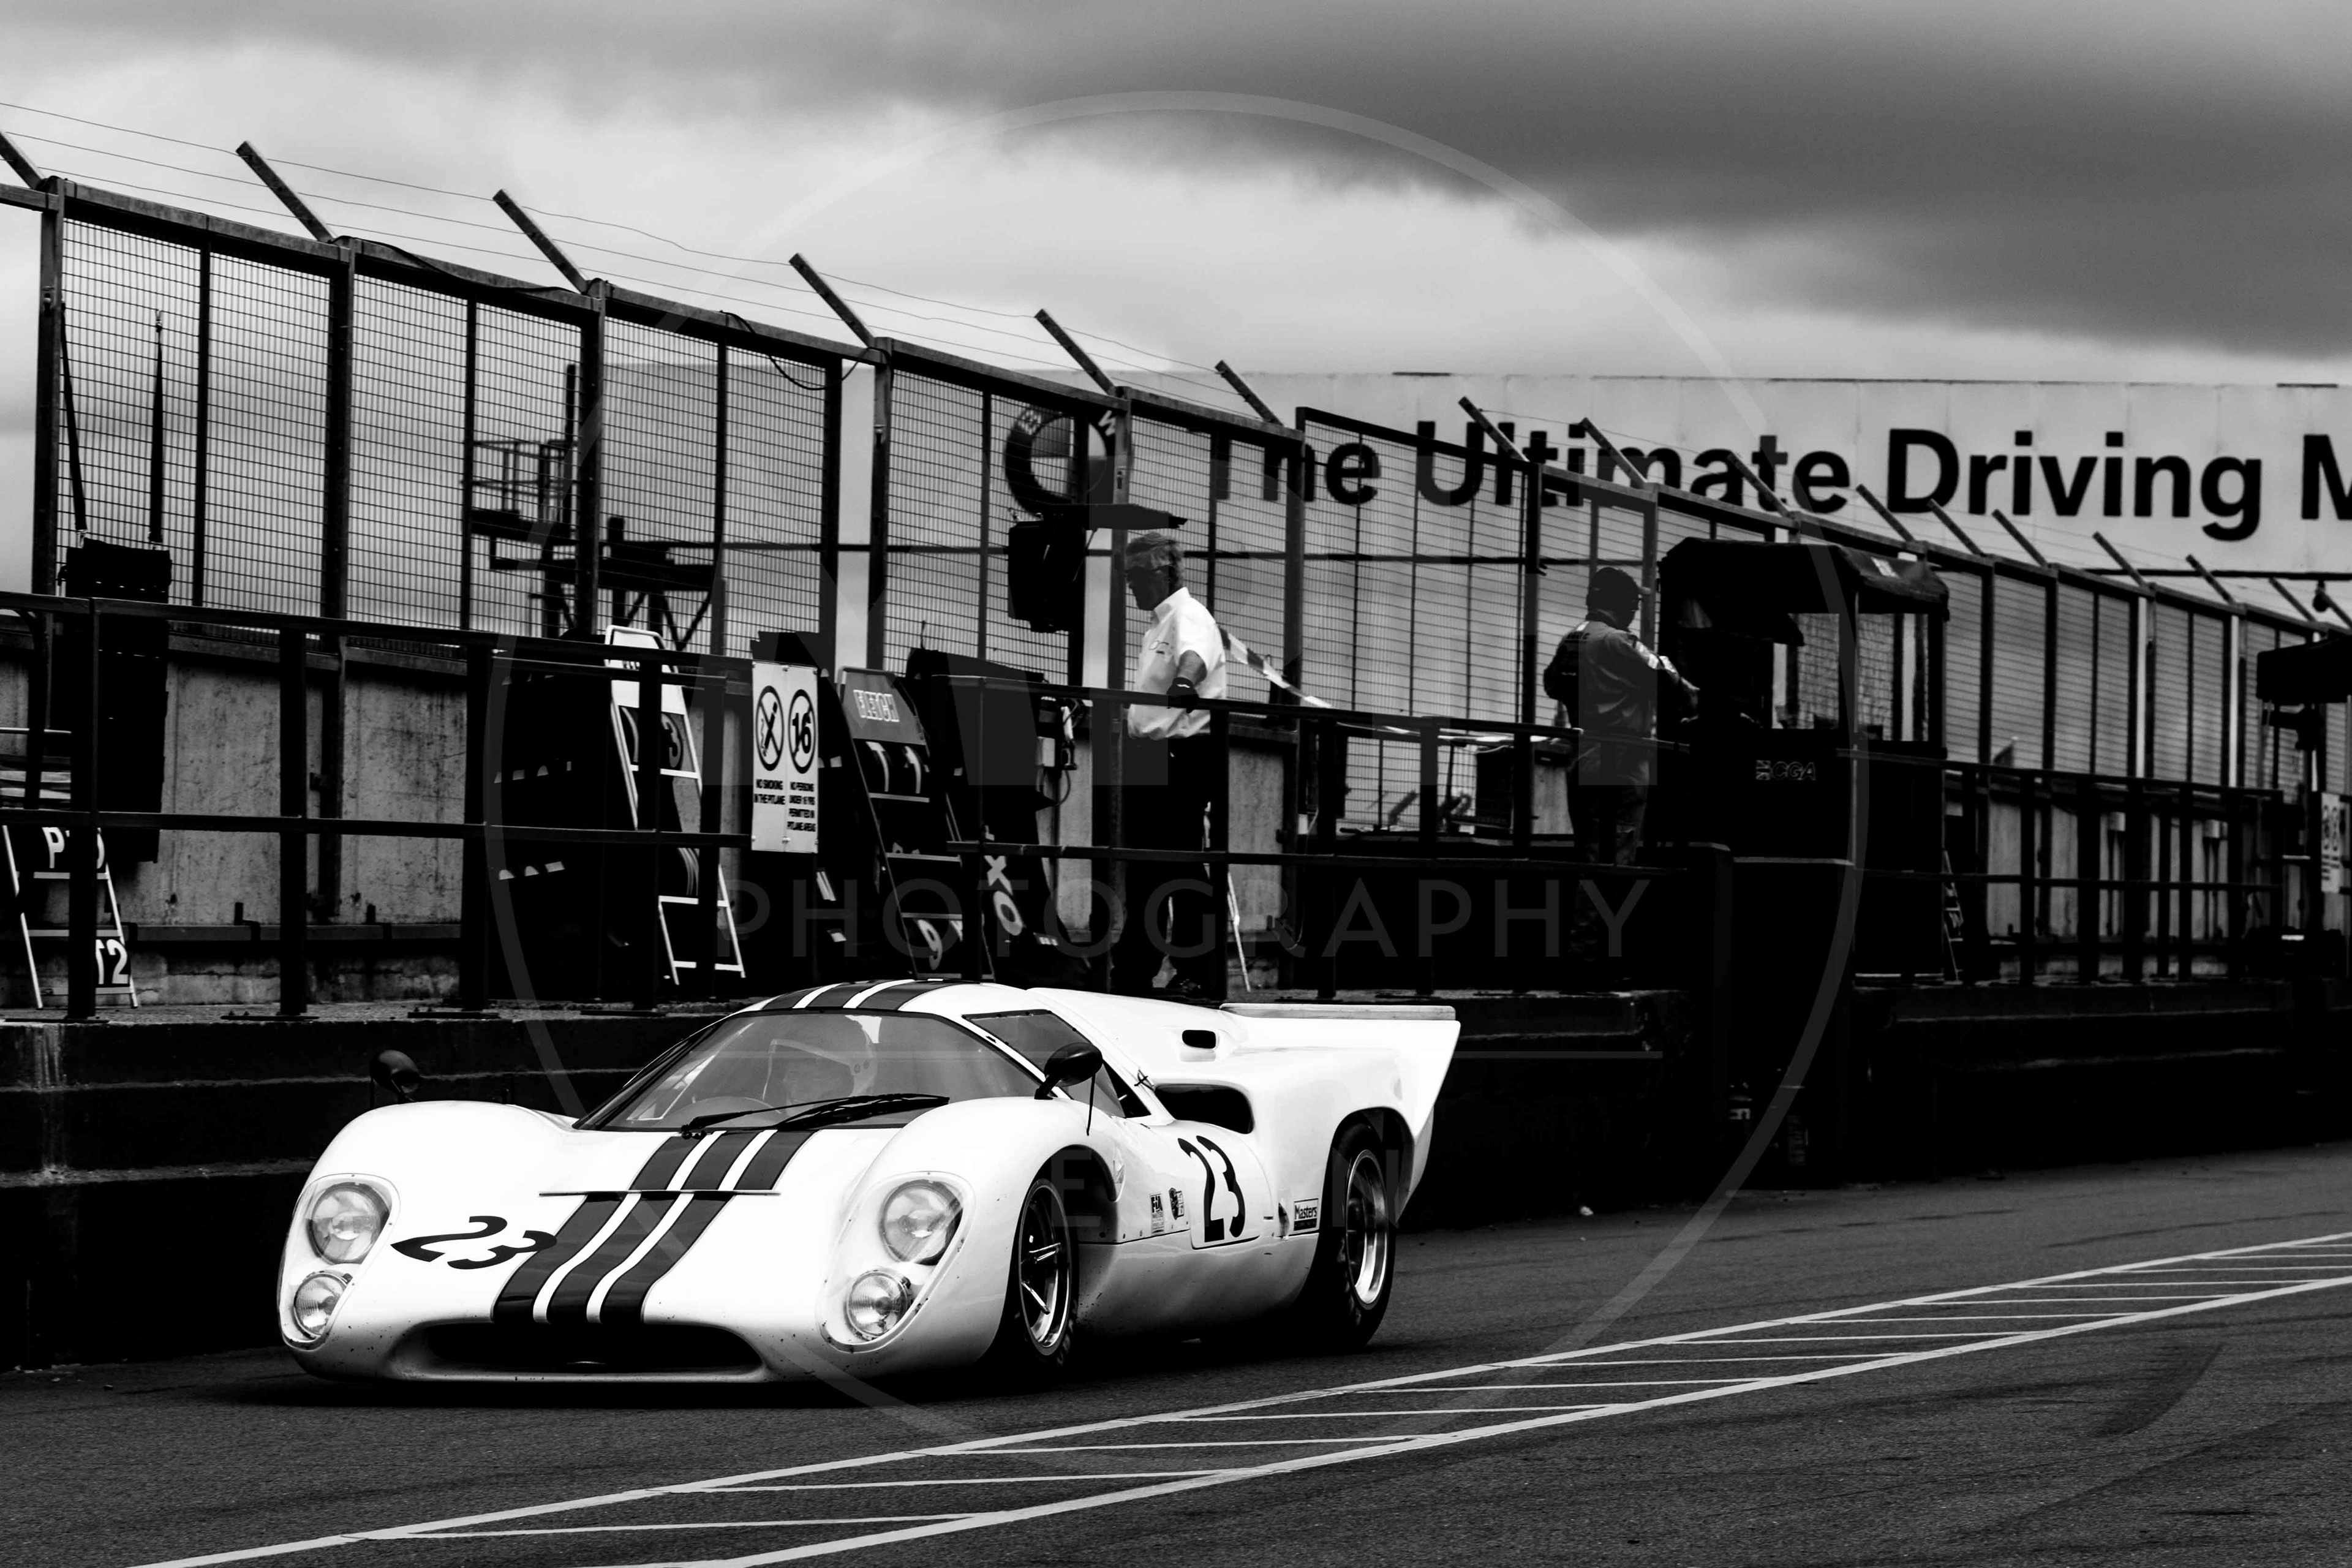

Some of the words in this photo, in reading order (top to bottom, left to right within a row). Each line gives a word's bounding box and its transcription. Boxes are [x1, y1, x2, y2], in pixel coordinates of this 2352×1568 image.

[1415, 421, 1850, 513] Ultimate
[1888, 428, 2262, 541] Driving
[792, 712, 812, 754] 16
[1177, 1136, 1246, 1243] 23
[1294, 1205, 1317, 1219] Masters
[390, 1216, 557, 1270] 23
